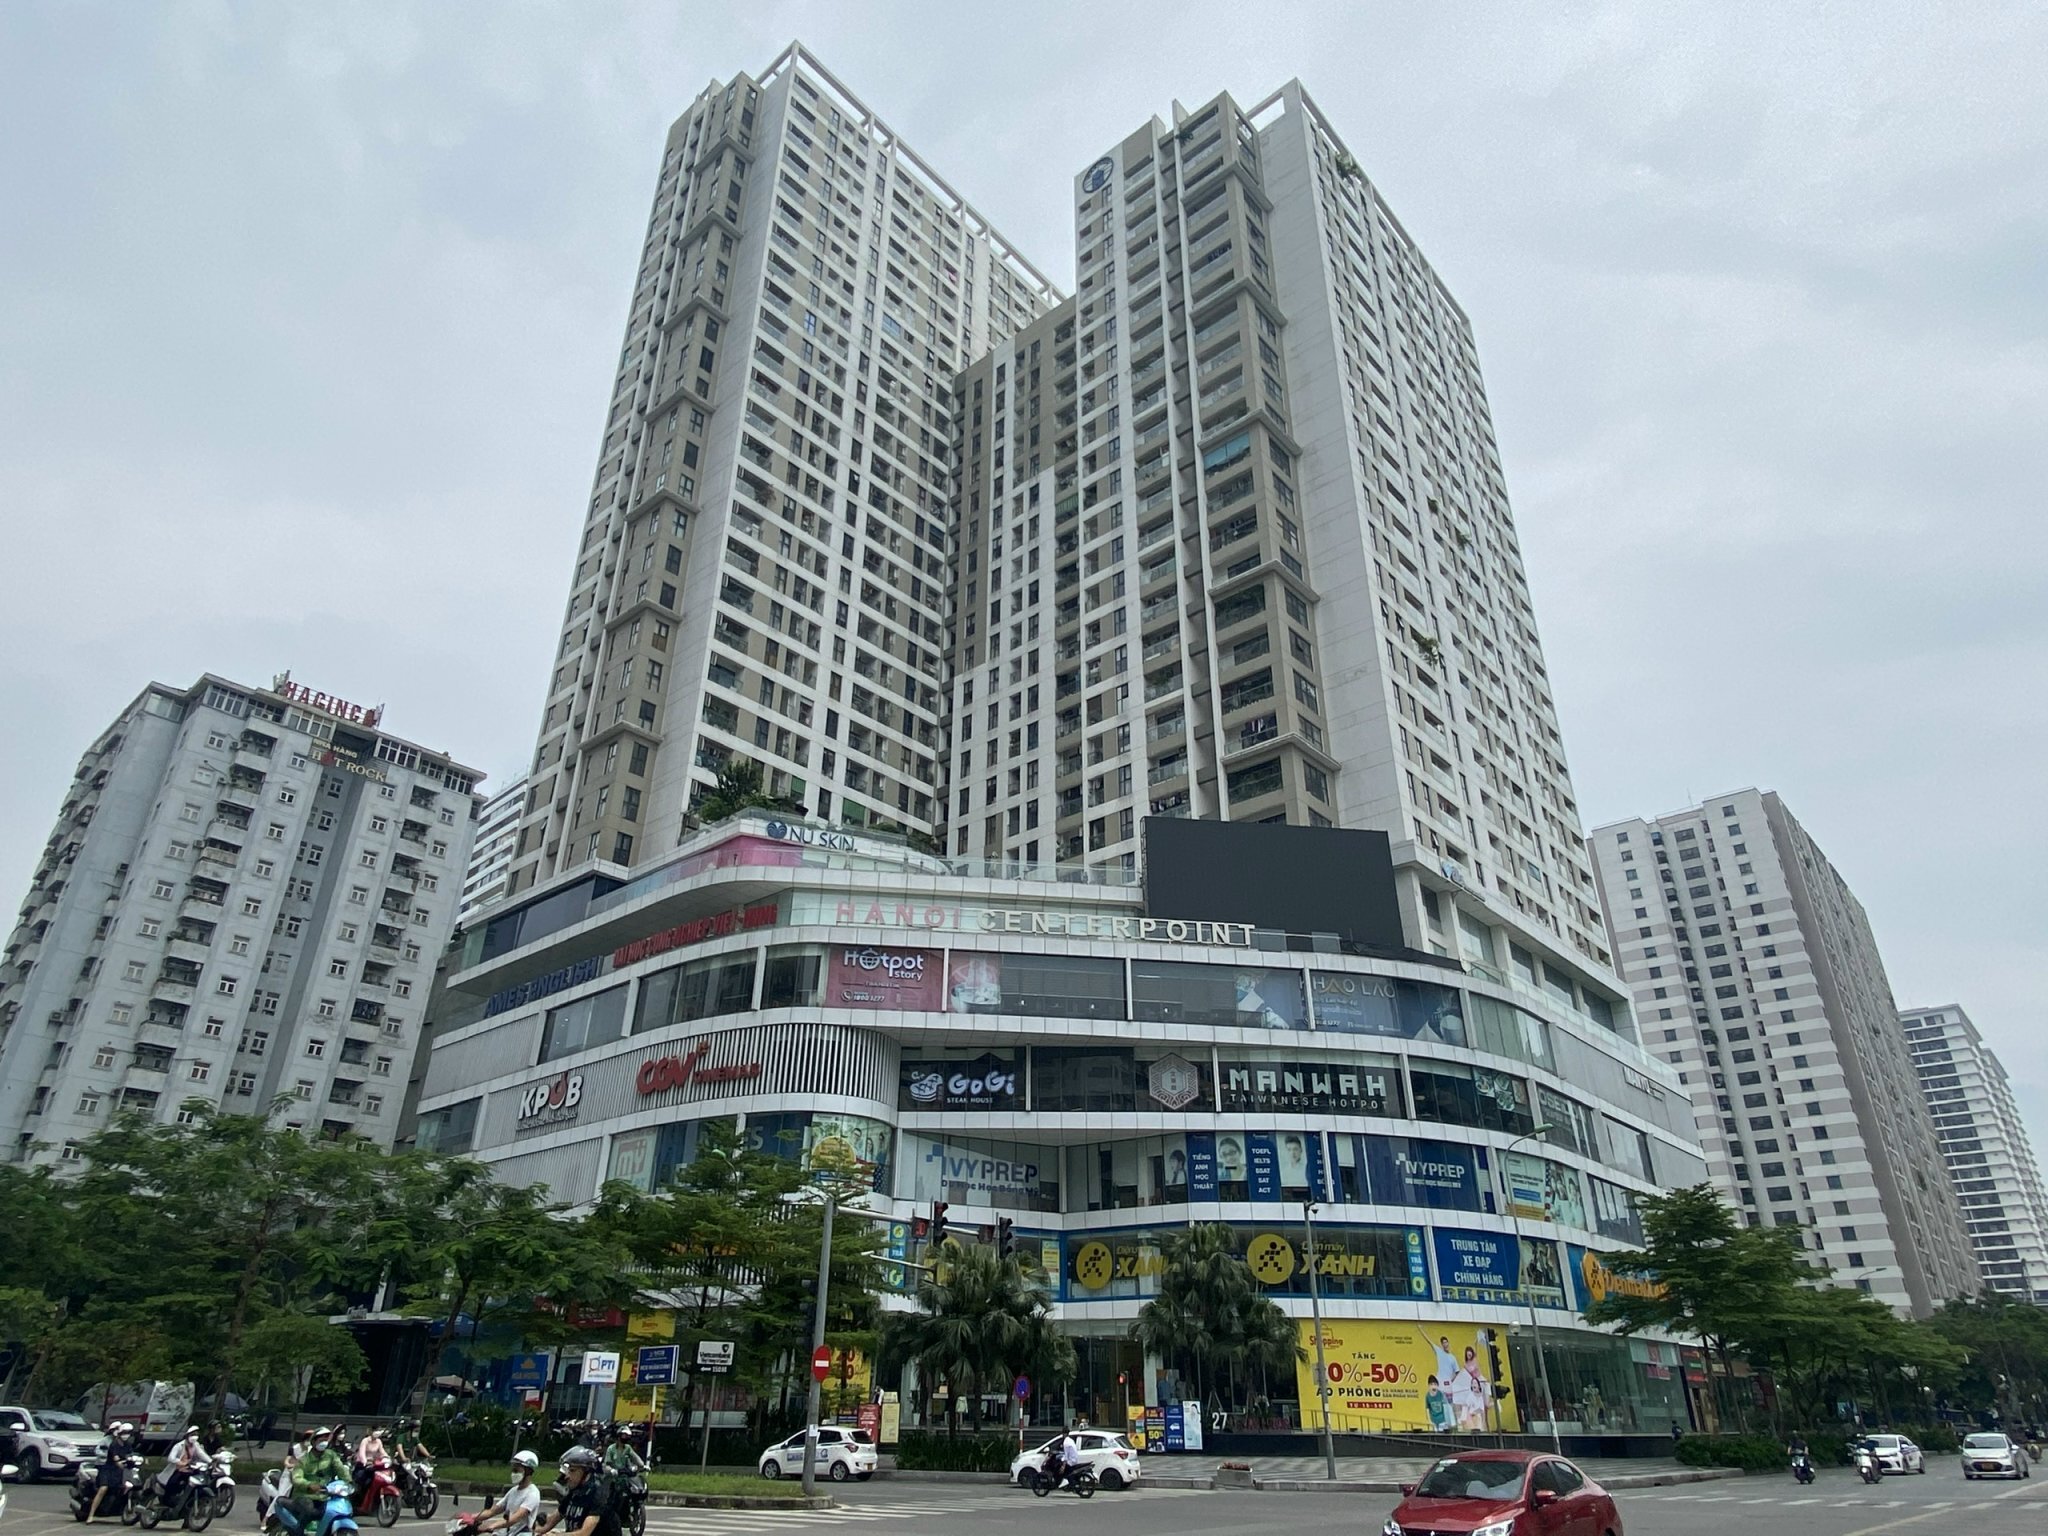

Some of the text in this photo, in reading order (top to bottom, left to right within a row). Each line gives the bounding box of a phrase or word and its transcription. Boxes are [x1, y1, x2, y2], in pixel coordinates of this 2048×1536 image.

[346, 761, 386, 783] ROCK
[790, 826, 813, 844] NU
[836, 901, 1256, 947] HANOI CENTERPOINT
[844, 948, 924, 978] Hotpot
[895, 970, 923, 981] story
[637, 1051, 696, 1095] CGV
[1229, 1069, 1387, 1097] MANWAH
[1230, 1093, 1388, 1109] TAIWANESE HOTPOT
[942, 1156, 1038, 1184] IVYPREP
[1450, 1239, 1498, 1254] TRUNG TÂM
[1299, 1253, 1375, 1276] XANH
[1463, 1255, 1491, 1270] XE ĐẠP
[1454, 1269, 1481, 1284] CHÍNH
[601, 1359, 615, 1371] PTI
[1338, 1385, 1381, 1397] PHÔNG
[1212, 1412, 1228, 1430] 27
